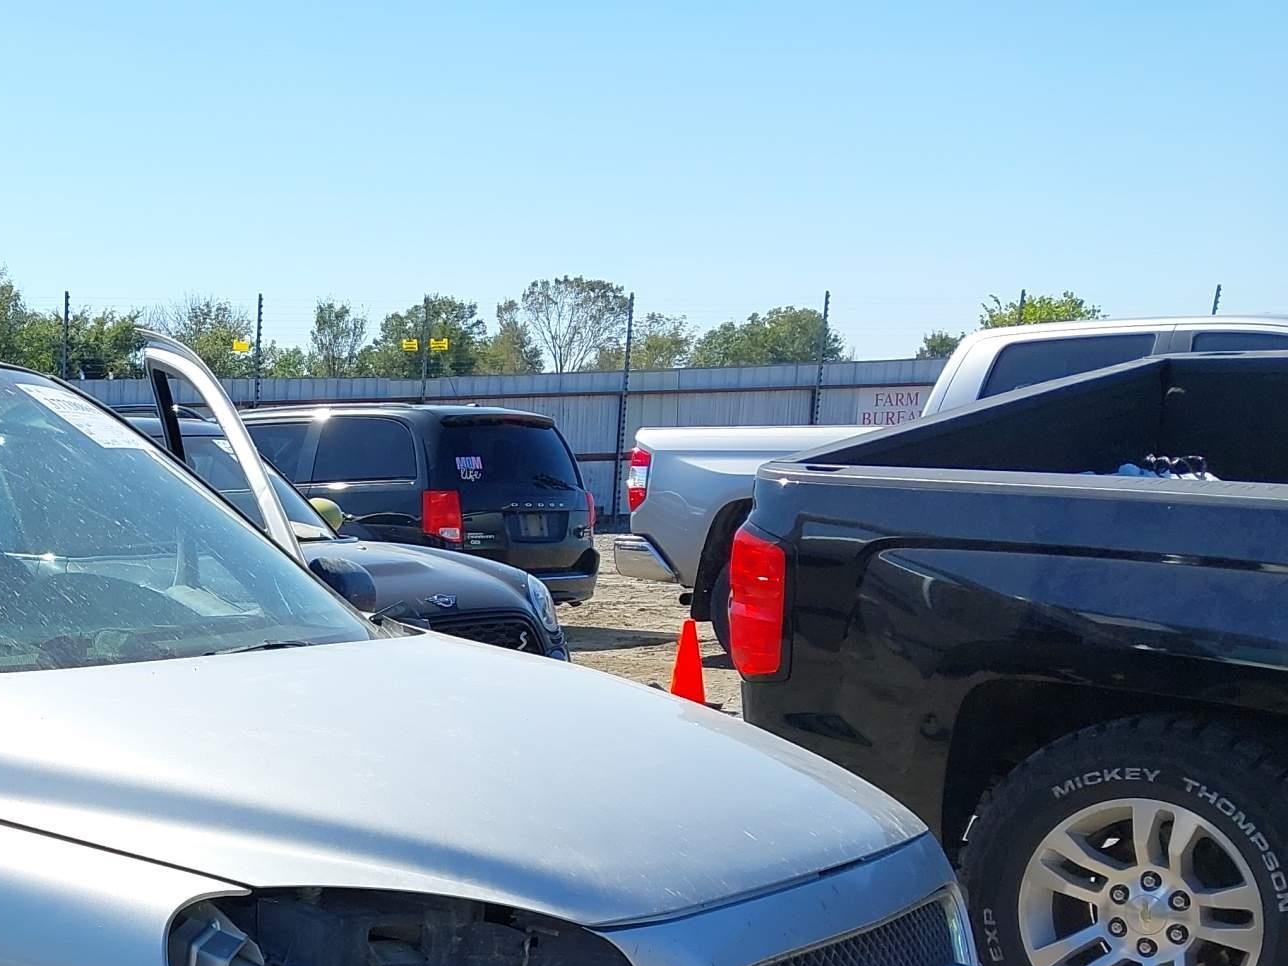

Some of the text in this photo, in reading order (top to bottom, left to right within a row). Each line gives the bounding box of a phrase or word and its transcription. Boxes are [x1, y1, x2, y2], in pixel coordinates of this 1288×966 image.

[874, 392, 920, 407] FARM
[862, 409, 923, 426] BUREA
[455, 456, 483, 470] MOM
[1051, 767, 1288, 913] MICKEY THOMPSON
[983, 907, 1005, 962] EXP
